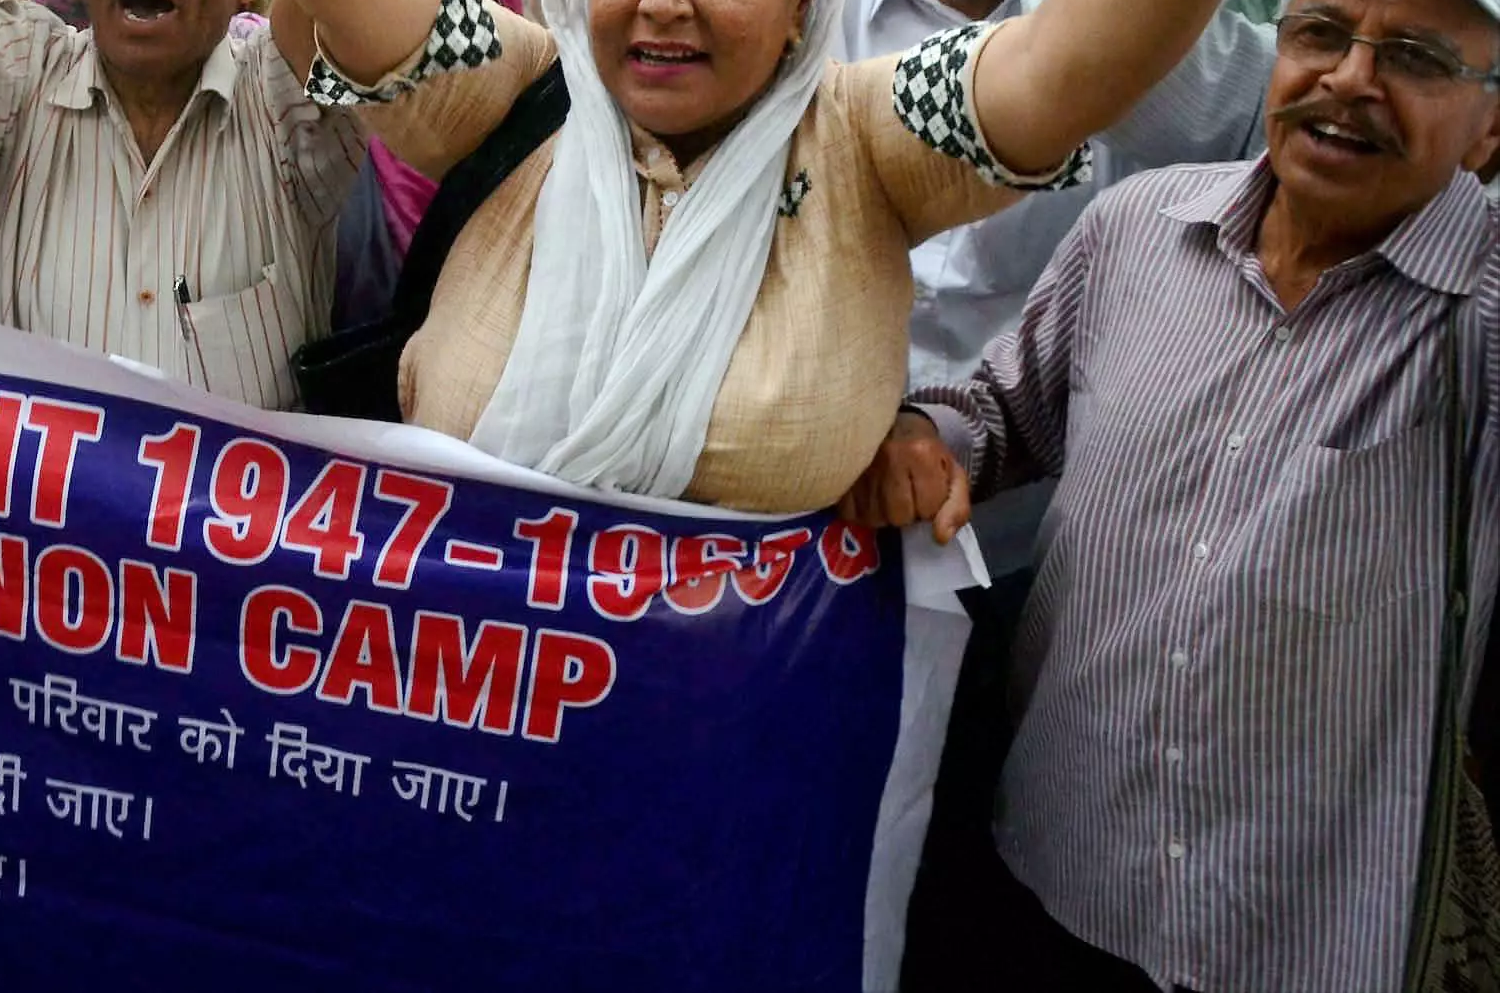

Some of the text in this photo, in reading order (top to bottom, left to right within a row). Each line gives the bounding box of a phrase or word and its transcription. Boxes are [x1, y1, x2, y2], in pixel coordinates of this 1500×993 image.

[8, 673, 158, 751] परिवार
[177, 708, 245, 769] को
[265, 721, 372, 797] दिया
[239, 584, 617, 744] CAMP
